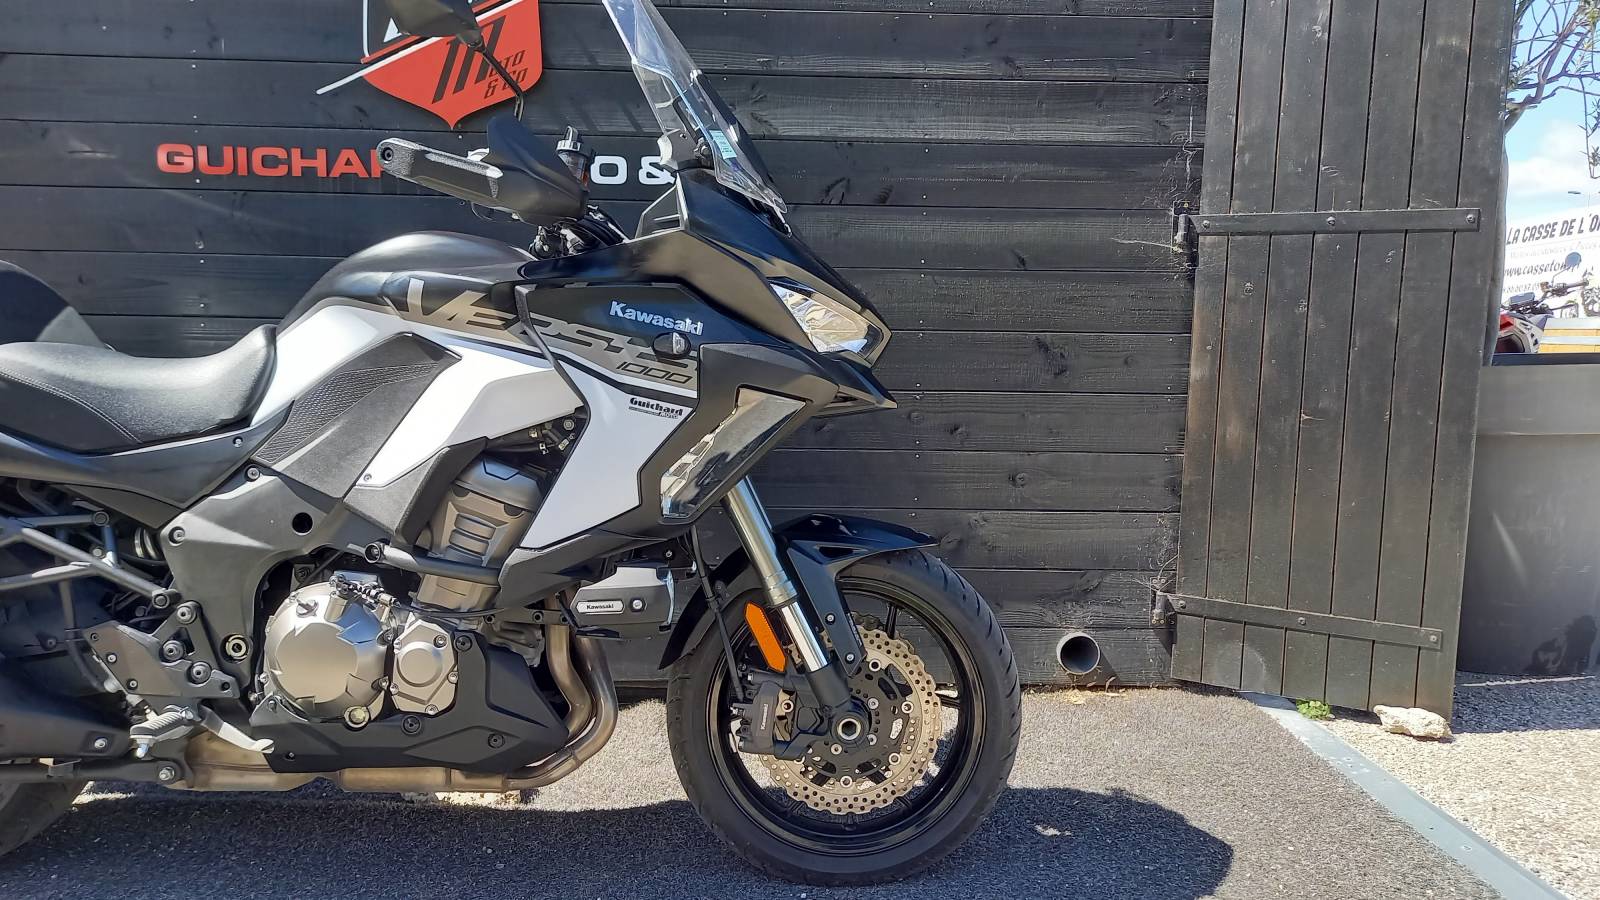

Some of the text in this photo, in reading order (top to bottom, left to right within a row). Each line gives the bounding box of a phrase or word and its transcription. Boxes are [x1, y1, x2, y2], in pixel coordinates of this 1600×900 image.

[639, 155, 676, 185] &
[1506, 227, 1521, 245] LA
[1522, 222, 1558, 243] CASSE
[1559, 218, 1577, 237] DE
[609, 300, 704, 336] Kawasaki
[616, 361, 693, 384] 1000
[629, 397, 684, 417] Guichard
